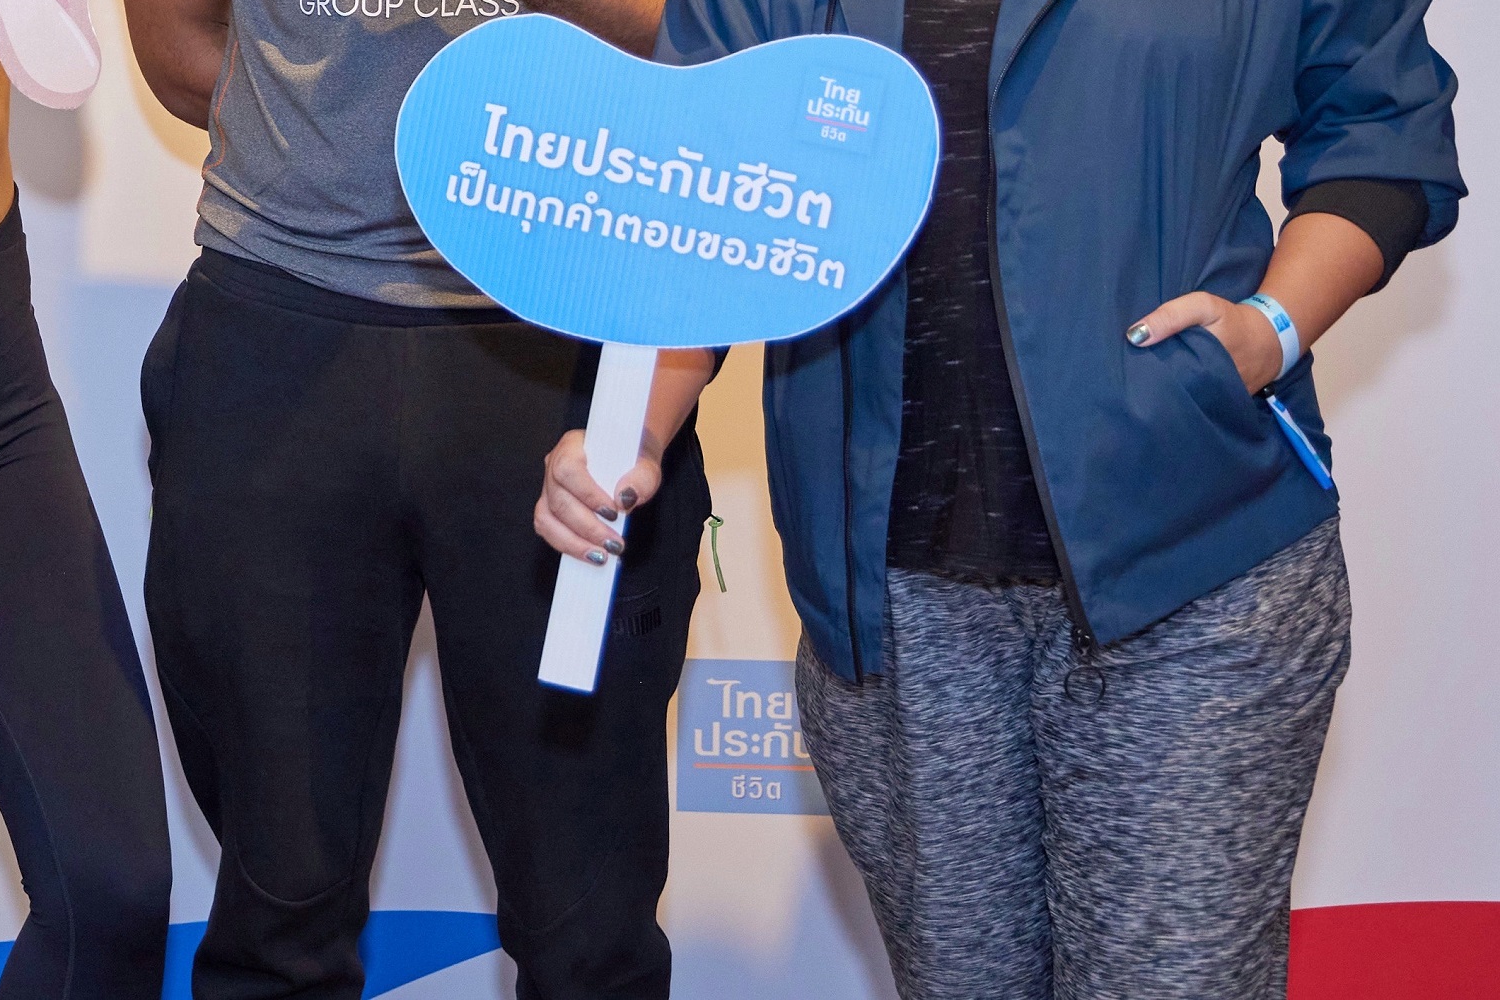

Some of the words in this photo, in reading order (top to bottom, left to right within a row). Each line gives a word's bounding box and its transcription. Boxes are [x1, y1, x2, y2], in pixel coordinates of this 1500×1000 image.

[819, 76, 861, 104] ไทย
[807, 97, 870, 126] ประกัน
[483, 103, 833, 230] ไทยประกันชีวิต
[445, 160, 846, 289] เป็นทุกคำตอบของชีวิต
[706, 678, 793, 720] ไทย
[731, 774, 782, 800] ชีวิต
